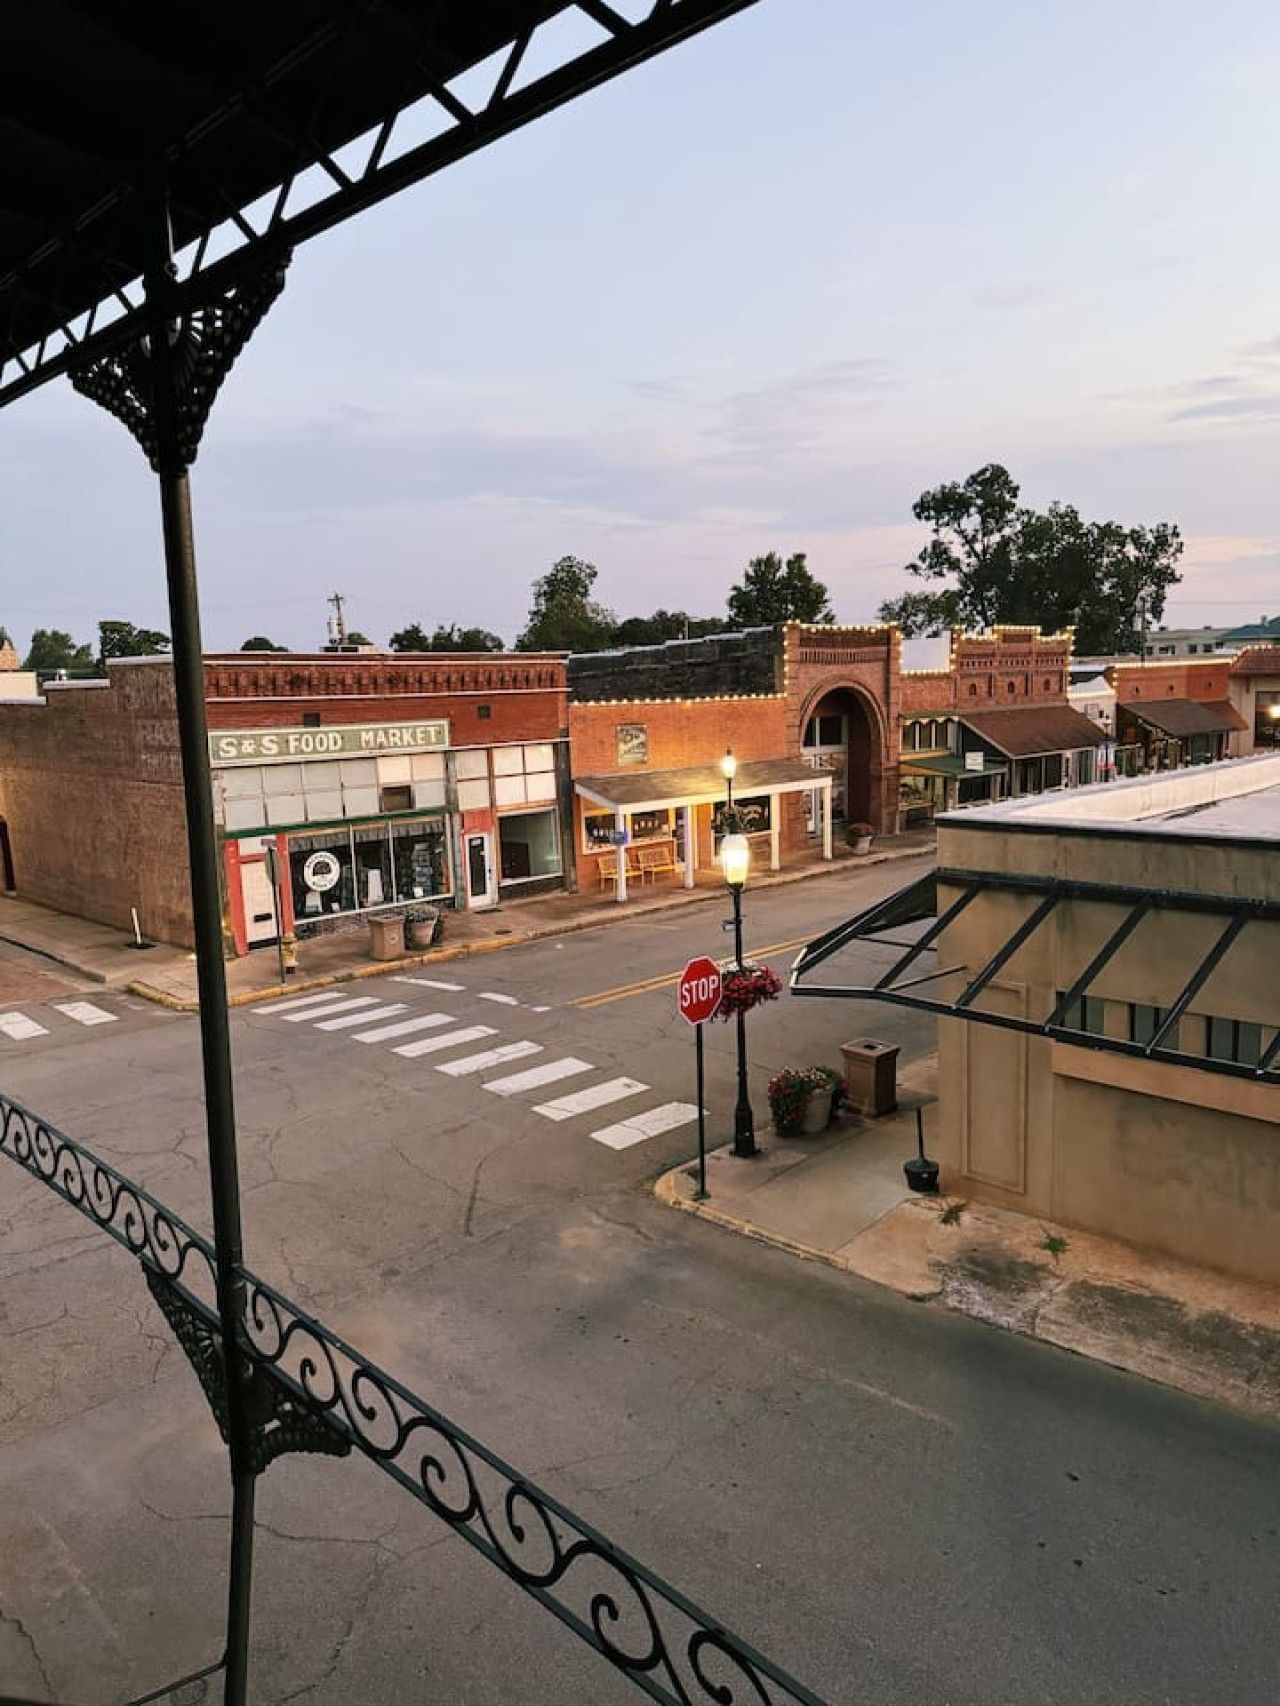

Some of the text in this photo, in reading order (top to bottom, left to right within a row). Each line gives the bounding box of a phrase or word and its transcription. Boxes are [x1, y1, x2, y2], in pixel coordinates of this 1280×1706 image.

[218, 726, 440, 758] S&S FOOD MARKET
[682, 975, 719, 1007] STOP
